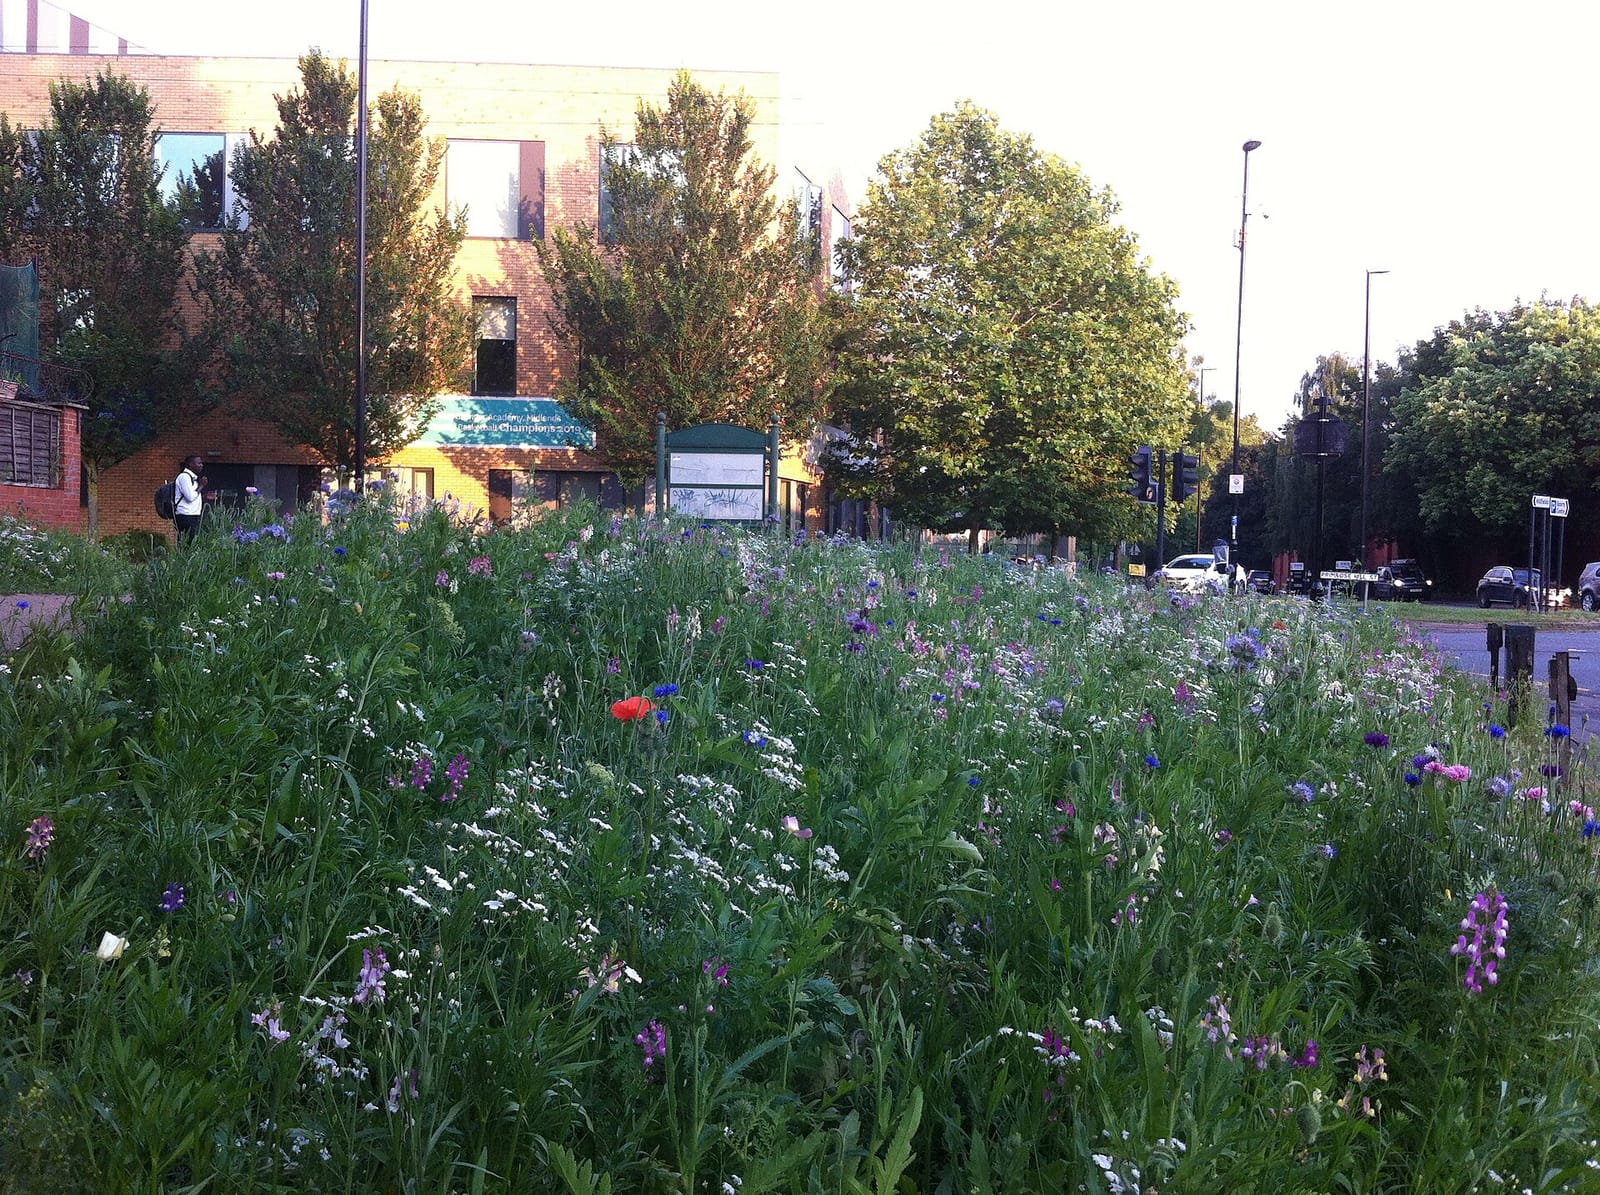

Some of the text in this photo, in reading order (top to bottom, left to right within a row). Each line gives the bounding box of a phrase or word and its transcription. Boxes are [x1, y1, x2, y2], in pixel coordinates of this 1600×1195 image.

[527, 413, 562, 423] Midlands
[498, 423, 555, 434] Champions
[558, 425, 581, 434] 2019
